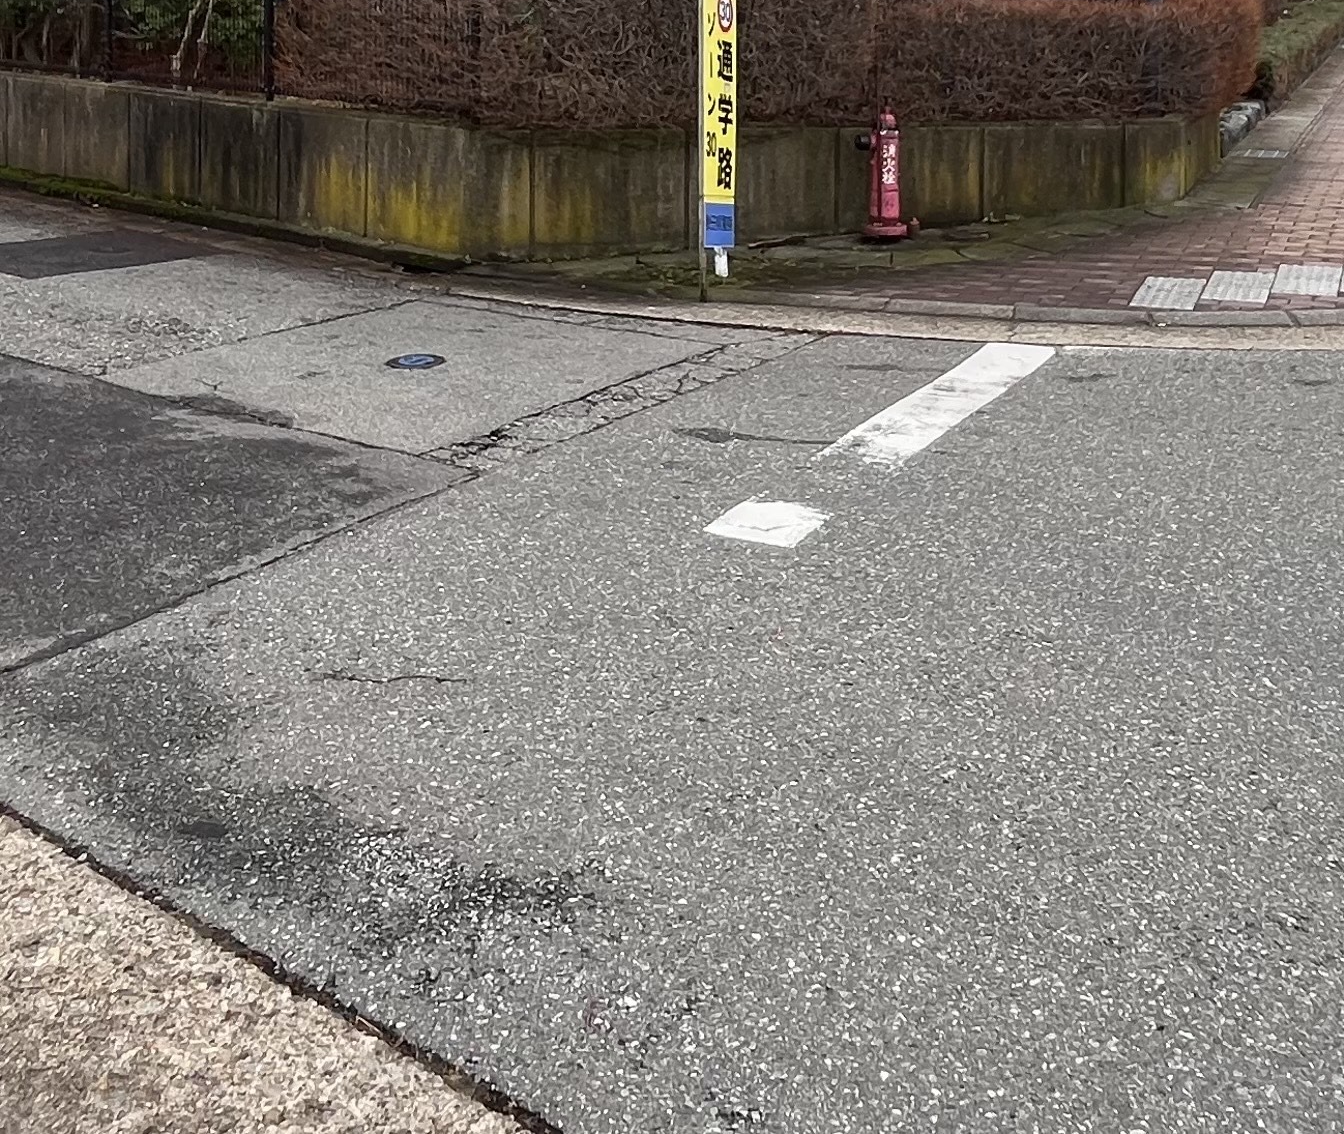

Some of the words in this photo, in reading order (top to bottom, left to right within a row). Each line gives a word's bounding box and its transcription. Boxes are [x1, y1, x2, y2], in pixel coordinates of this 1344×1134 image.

[720, 1, 732, 23] 30
[717, 39, 733, 190] 通学路
[881, 143, 896, 184] 消火栓
